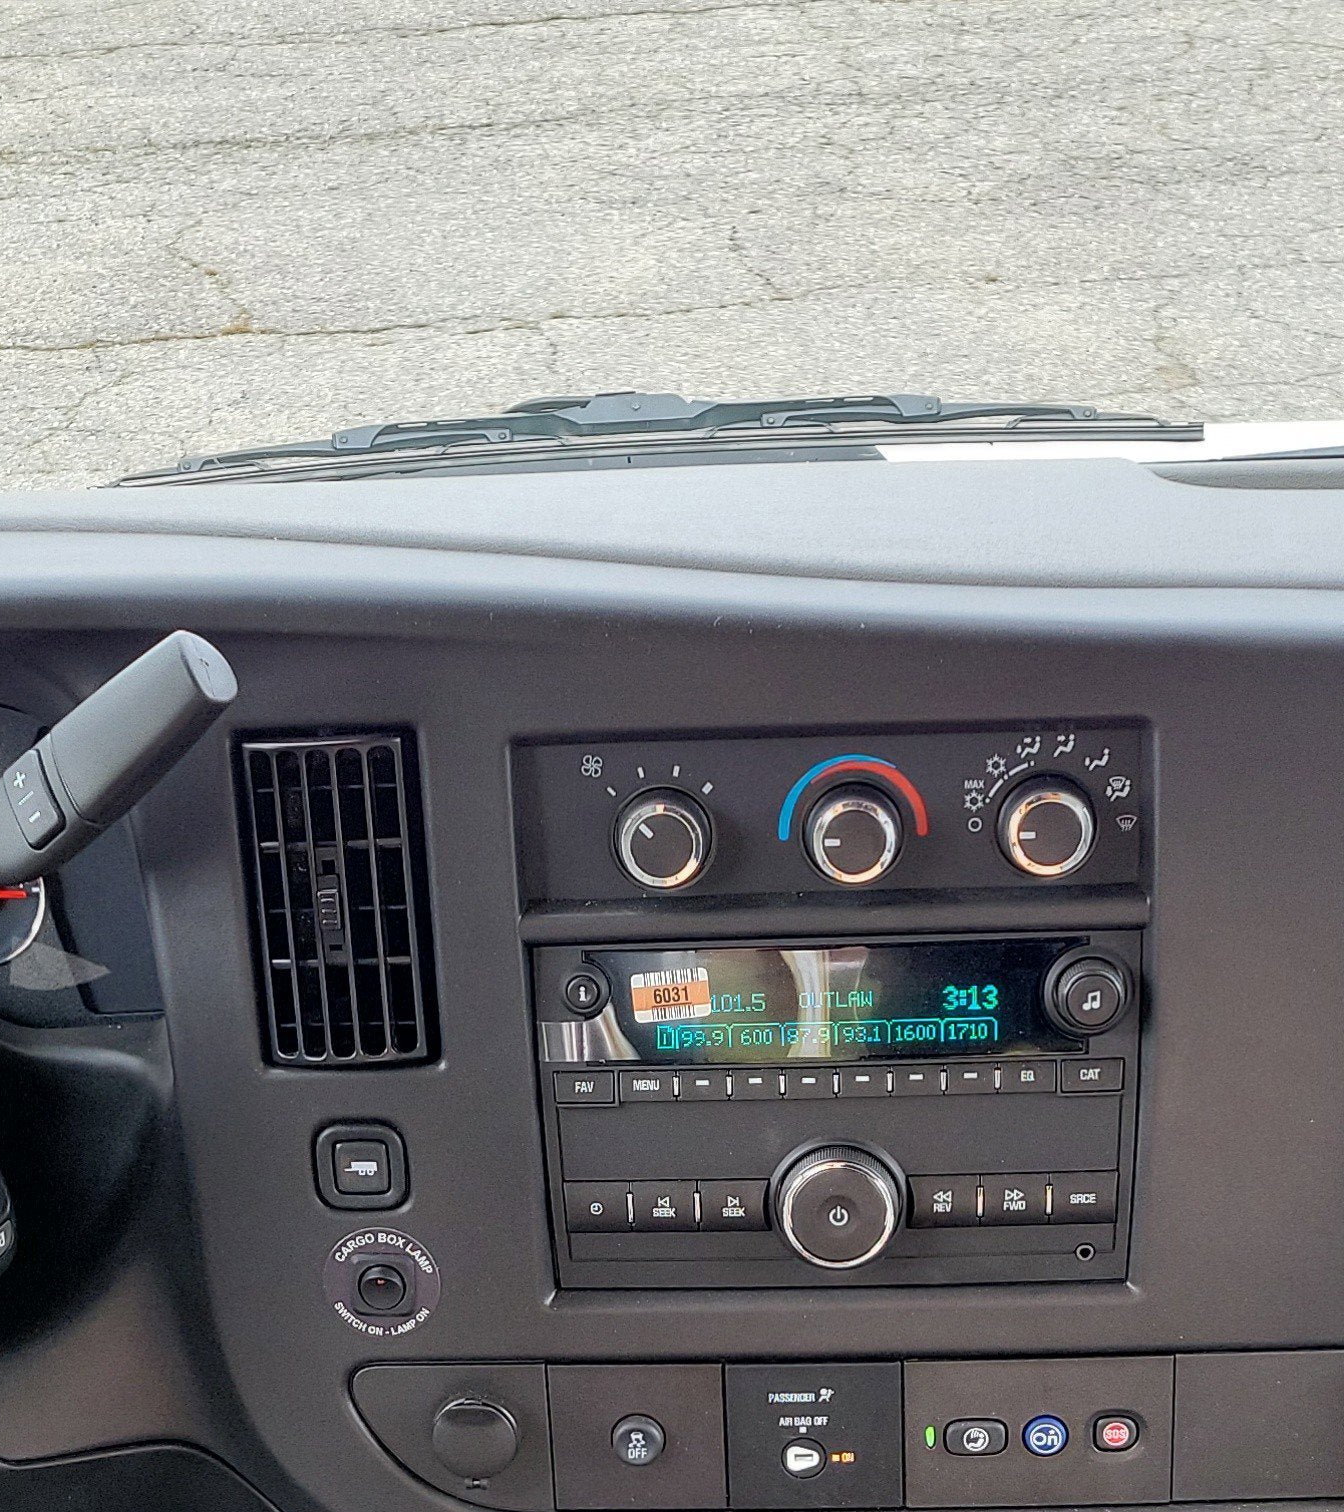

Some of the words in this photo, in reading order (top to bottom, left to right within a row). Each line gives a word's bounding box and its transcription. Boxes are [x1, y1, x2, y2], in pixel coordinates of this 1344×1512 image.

[964, 780, 984, 789] MAX
[653, 985, 690, 1004] 6031
[710, 992, 766, 1013] 101.5
[798, 990, 873, 1009] OUTLAW
[942, 984, 999, 1010] 3:13
[681, 1030, 724, 1047] 99.9
[740, 1028, 773, 1046] 600
[787, 1028, 830, 1046] 87.9
[843, 1026, 881, 1043] 93.1
[895, 1025, 936, 1042] 1600
[948, 1023, 988, 1040] 1710
[1020, 1070, 1035, 1082] EQ
[1079, 1068, 1101, 1081] CAT
[574, 1081, 594, 1093] FAV
[633, 1079, 660, 1092] MENU
[1069, 1193, 1097, 1204] SRCE
[933, 1202, 952, 1213] REV
[1003, 1200, 1026, 1211] FWD
[652, 1207, 676, 1218] SEEK
[722, 1206, 746, 1218] SEEK
[335, 1233, 375, 1262] CARGO
[377, 1232, 406, 1249] BOX
[405, 1243, 433, 1274] LAMP
[334, 1301, 368, 1332] SWITCH
[367, 1325, 384, 1336] ON
[390, 1319, 416, 1336] LAMP
[416, 1307, 430, 1323] ON
[767, 1392, 816, 1404] PASSENGER
[778, 1416, 793, 1427] AIR
[793, 1416, 812, 1427] BAG
[813, 1415, 829, 1426] OFF
[1104, 1428, 1127, 1440] SOS
[627, 1448, 648, 1459] OFF
[841, 1452, 855, 1462] ON
